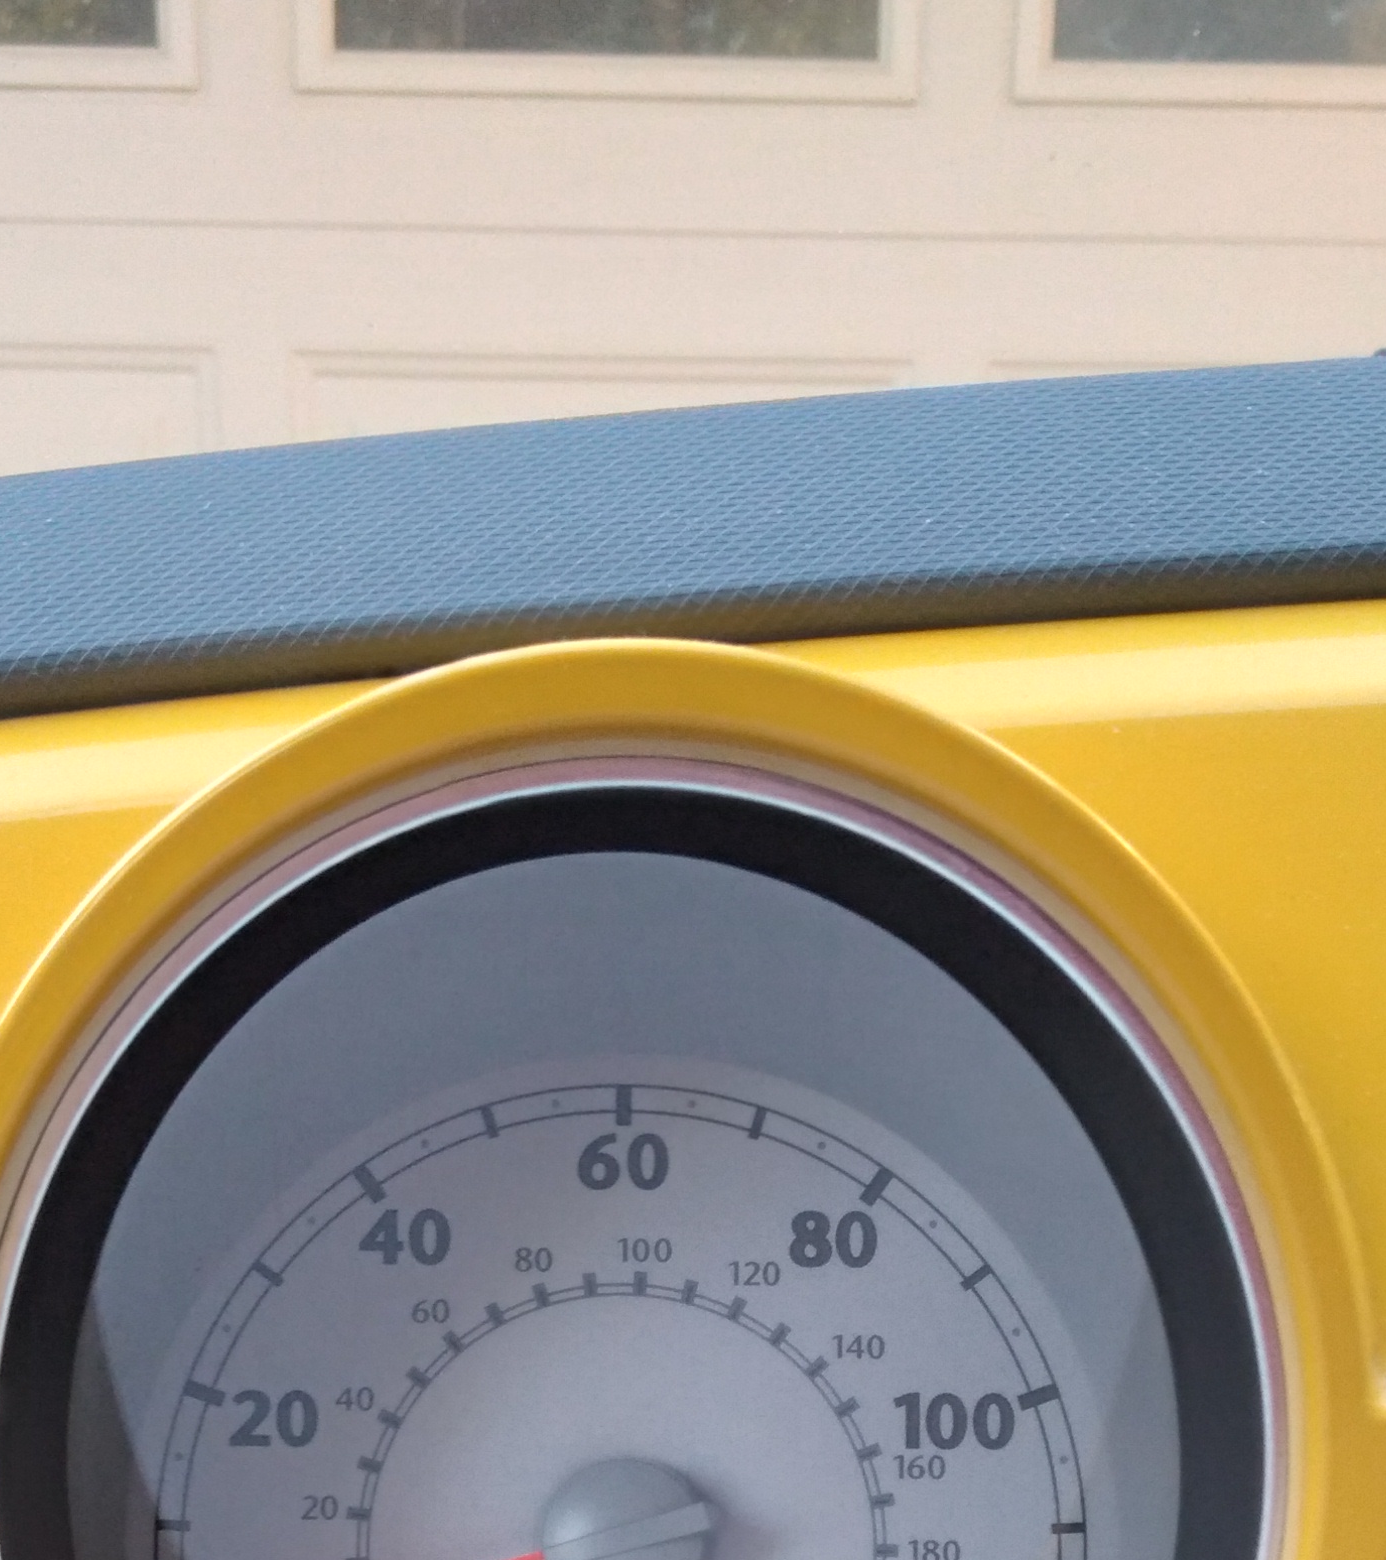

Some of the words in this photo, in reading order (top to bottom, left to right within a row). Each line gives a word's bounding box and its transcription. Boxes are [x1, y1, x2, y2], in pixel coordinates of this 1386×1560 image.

[576, 1132, 669, 1191] 60
[358, 1208, 451, 1266] 40
[616, 1237, 673, 1264] 100
[788, 1210, 878, 1268] 80
[514, 1246, 553, 1273] 80
[728, 1261, 781, 1287] 120
[411, 1298, 451, 1325] 60
[832, 1333, 886, 1360] 140
[334, 1386, 374, 1412] 40
[228, 1389, 319, 1448] 20
[892, 1392, 1016, 1451] 100
[893, 1454, 946, 1481] 160
[300, 1495, 339, 1521] 20
